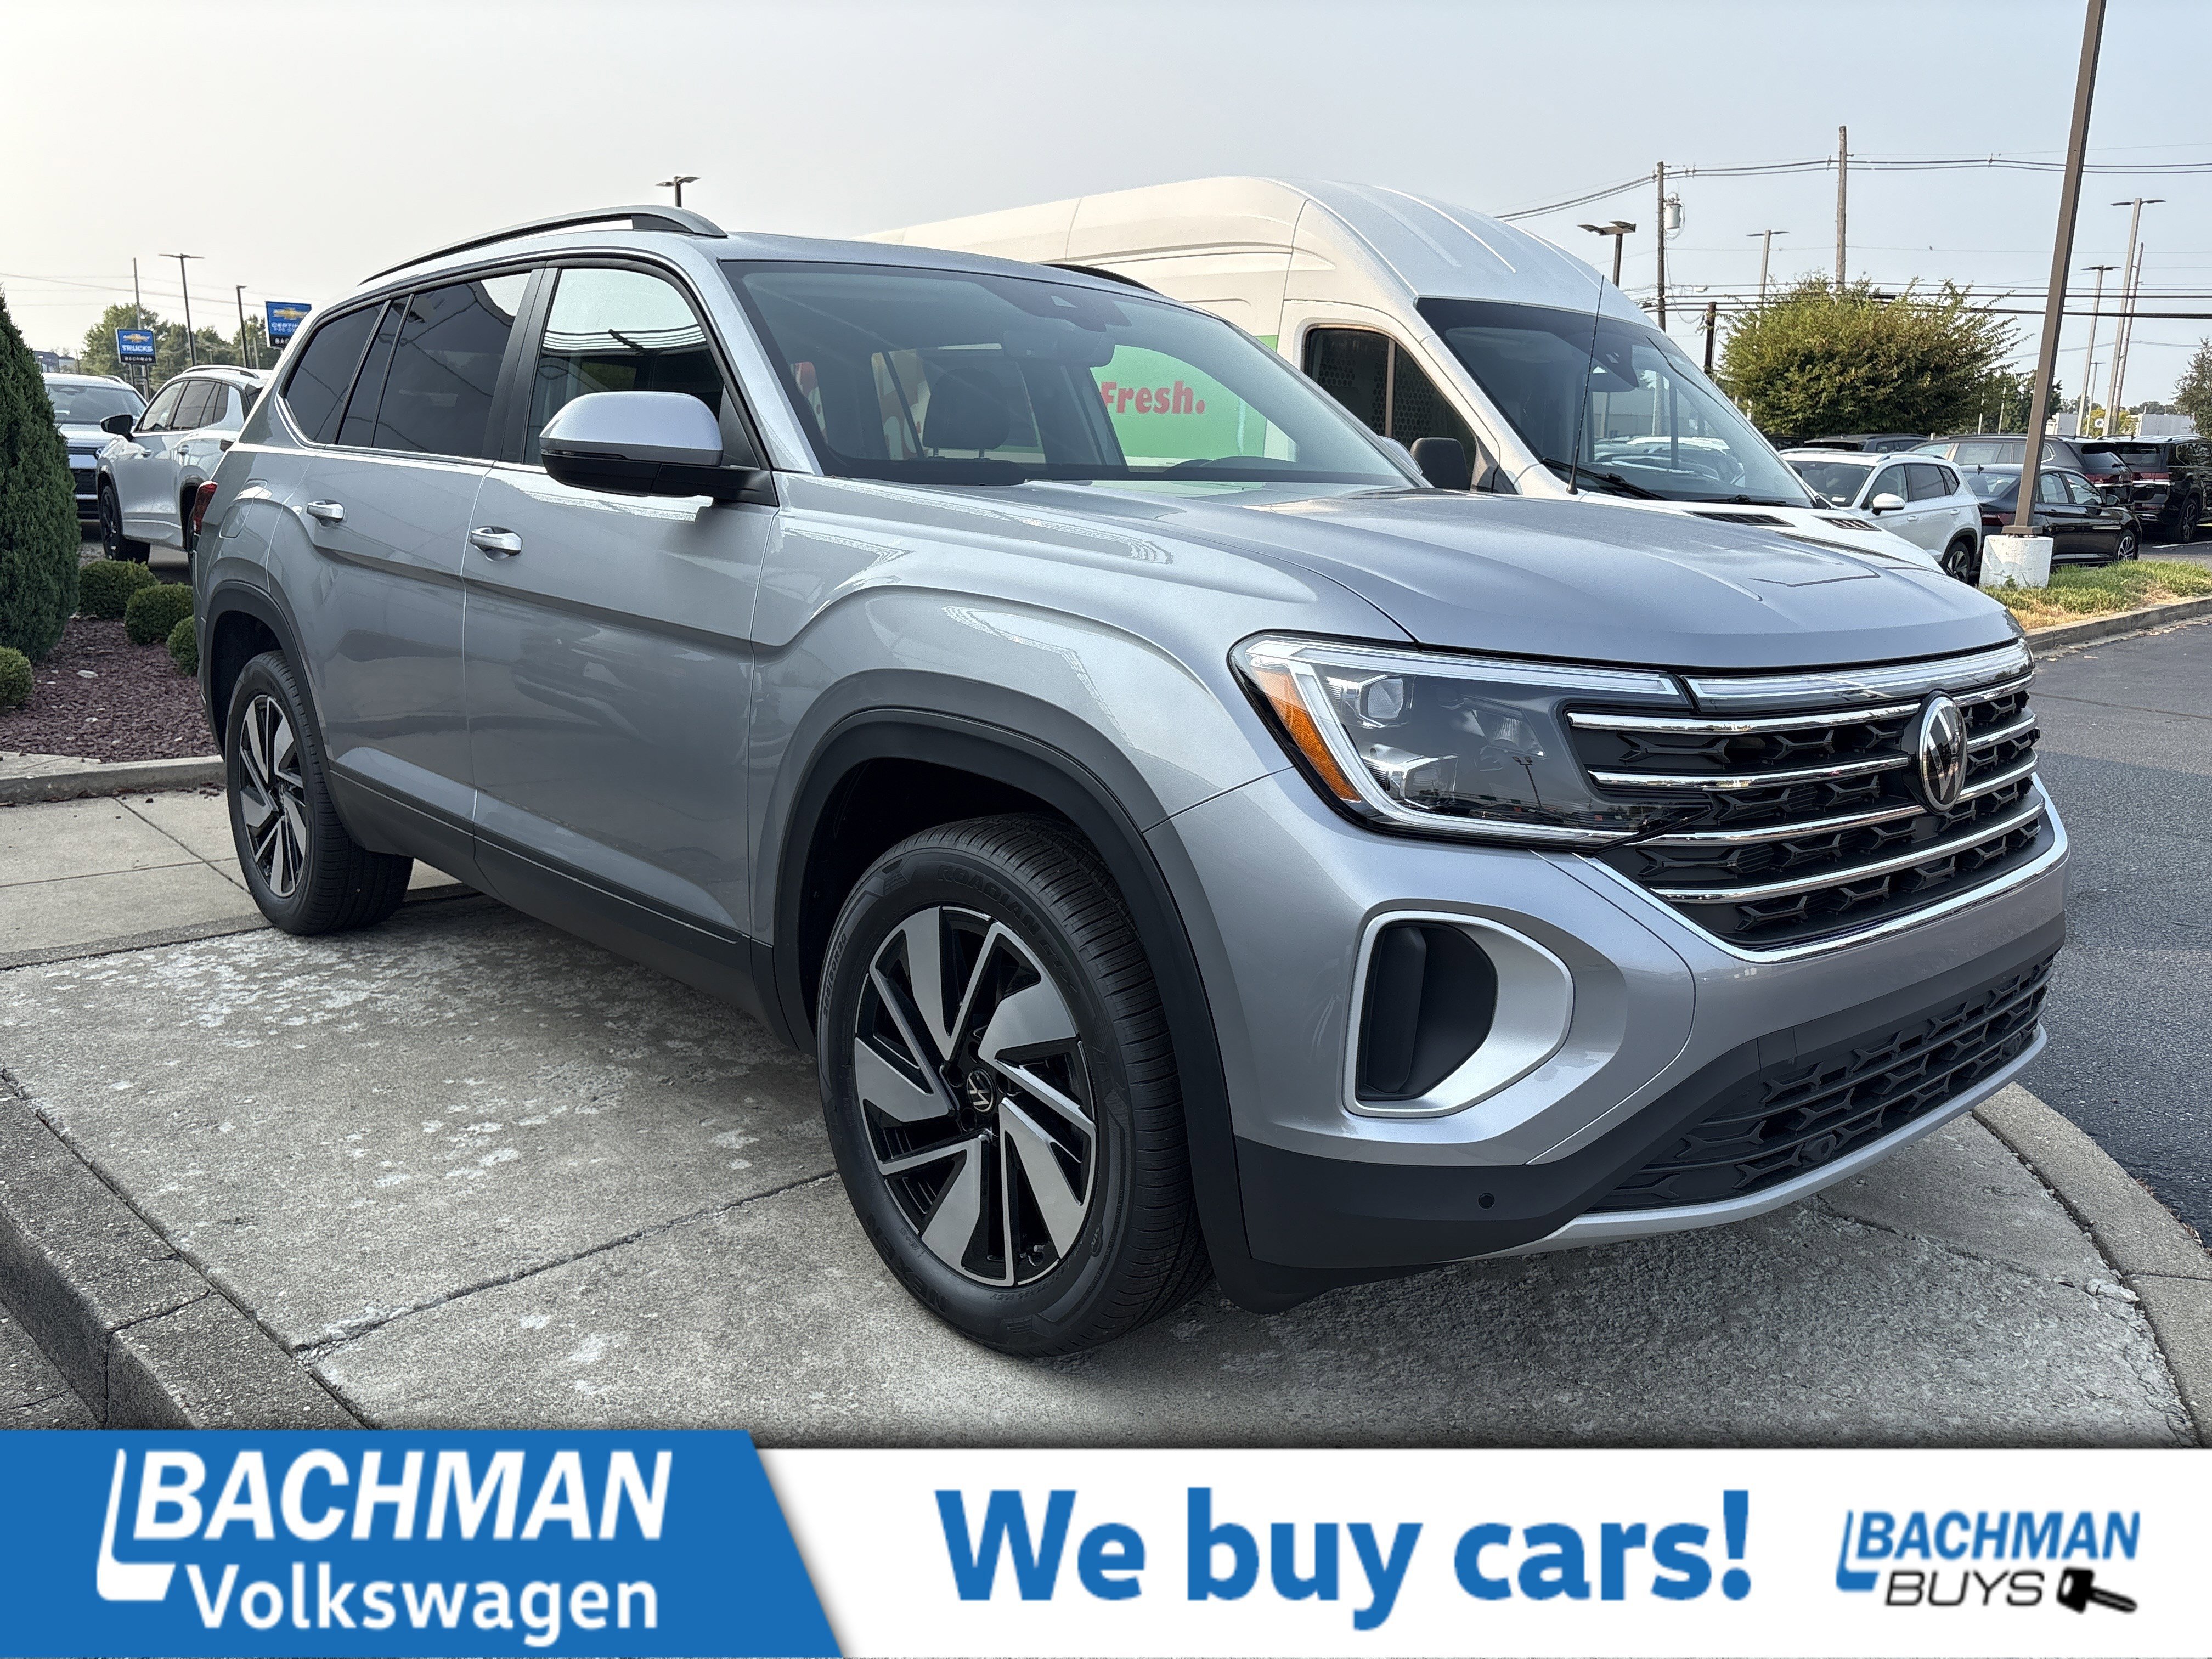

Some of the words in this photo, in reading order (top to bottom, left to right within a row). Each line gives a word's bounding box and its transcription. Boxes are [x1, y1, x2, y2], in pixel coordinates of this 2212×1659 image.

[1100, 381, 1206, 414] Fresh.
[937, 864, 1042, 936] ROADIAN
[866, 1212, 948, 1314] NEXEN
